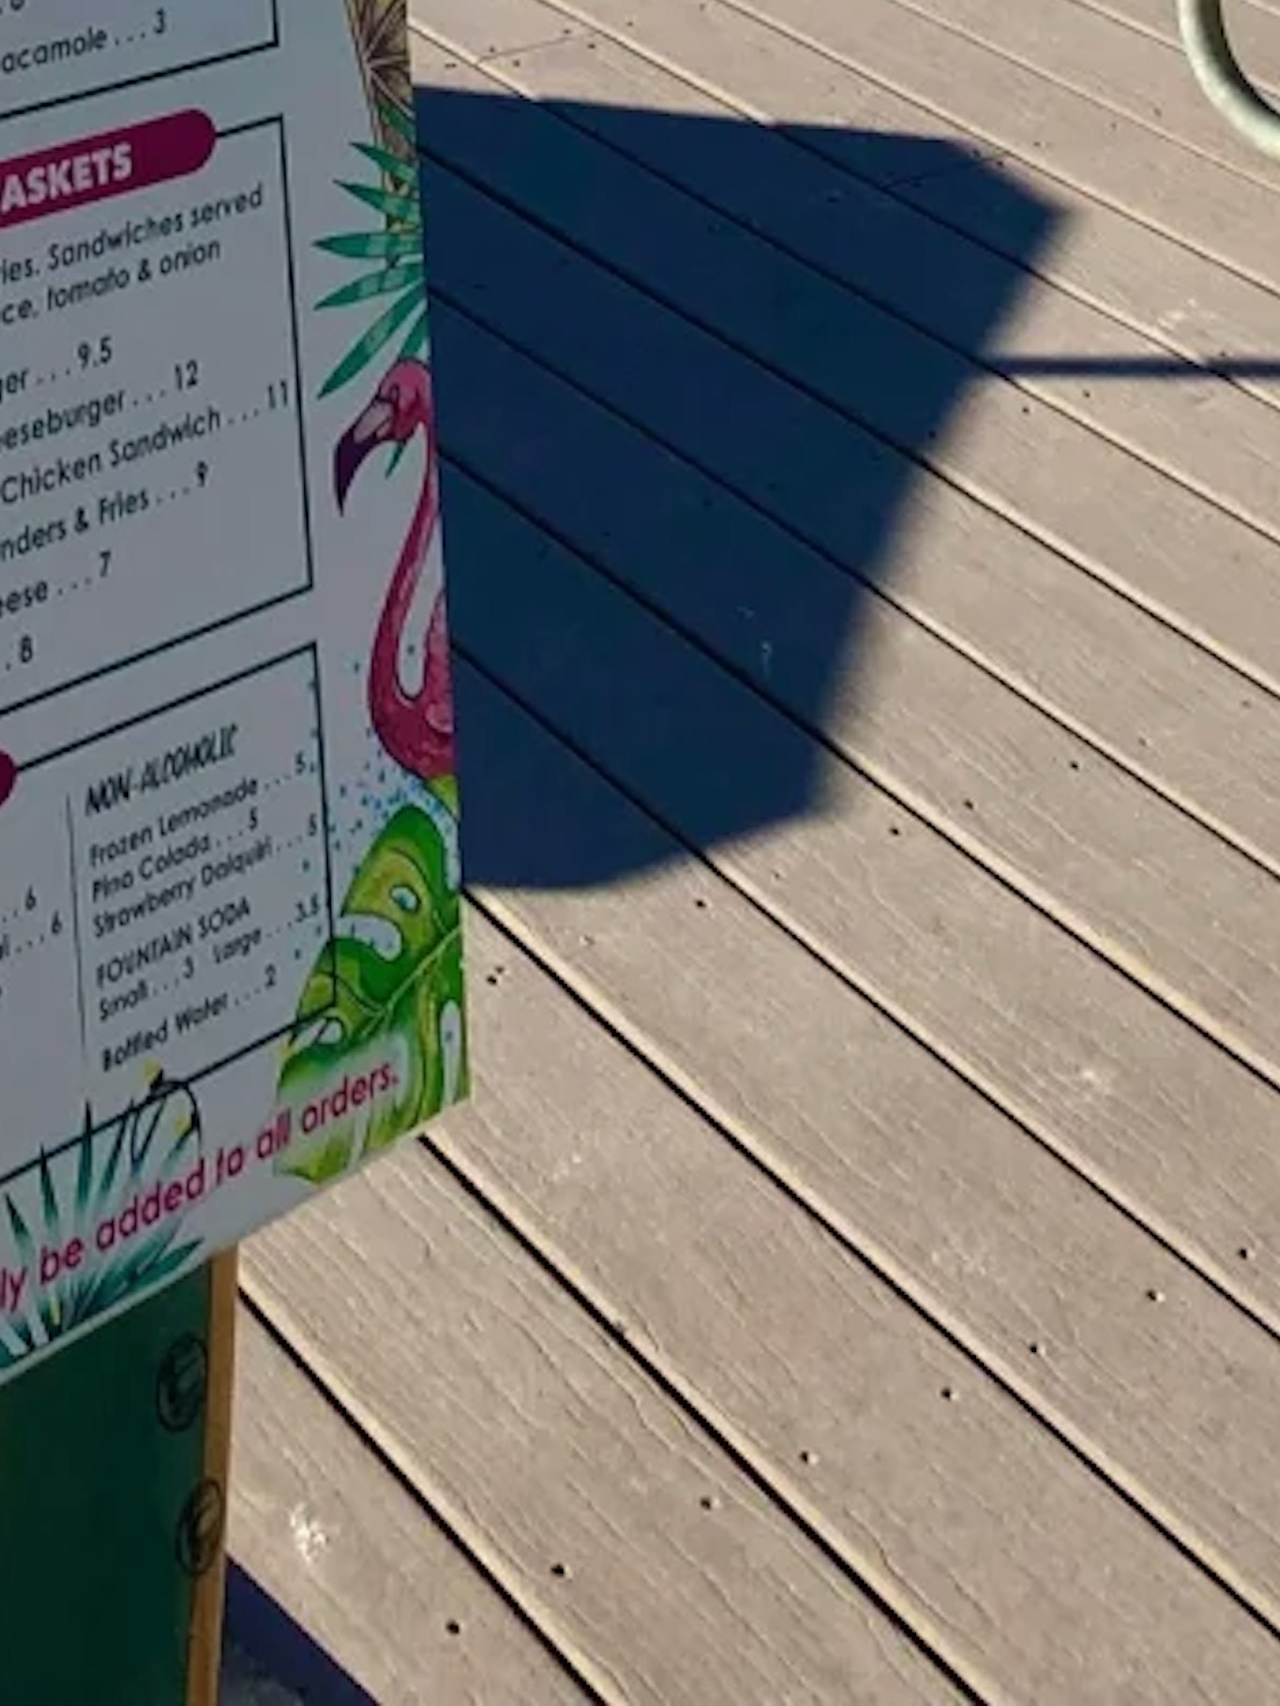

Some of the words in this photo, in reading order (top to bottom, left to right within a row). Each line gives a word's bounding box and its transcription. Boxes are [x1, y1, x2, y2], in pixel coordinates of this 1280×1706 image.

[48, 212, 184, 271] Sandwiches
[190, 182, 263, 228] served
[77, 335, 112, 370] 9.5
[174, 359, 198, 392] 12
[0, 452, 102, 505] Chicken
[108, 406, 221, 468] Sandwich
[267, 379, 288, 410] 11
[73, 506, 90, 535] &
[98, 488, 149, 526] Fries
[195, 460, 209, 488] 9
[18, 634, 34, 664] 8
[40, 1237, 83, 1286] be
[96, 1158, 206, 1250] added
[216, 1147, 244, 1185] to
[256, 1114, 291, 1160] all
[301, 1061, 400, 1133] orders.
